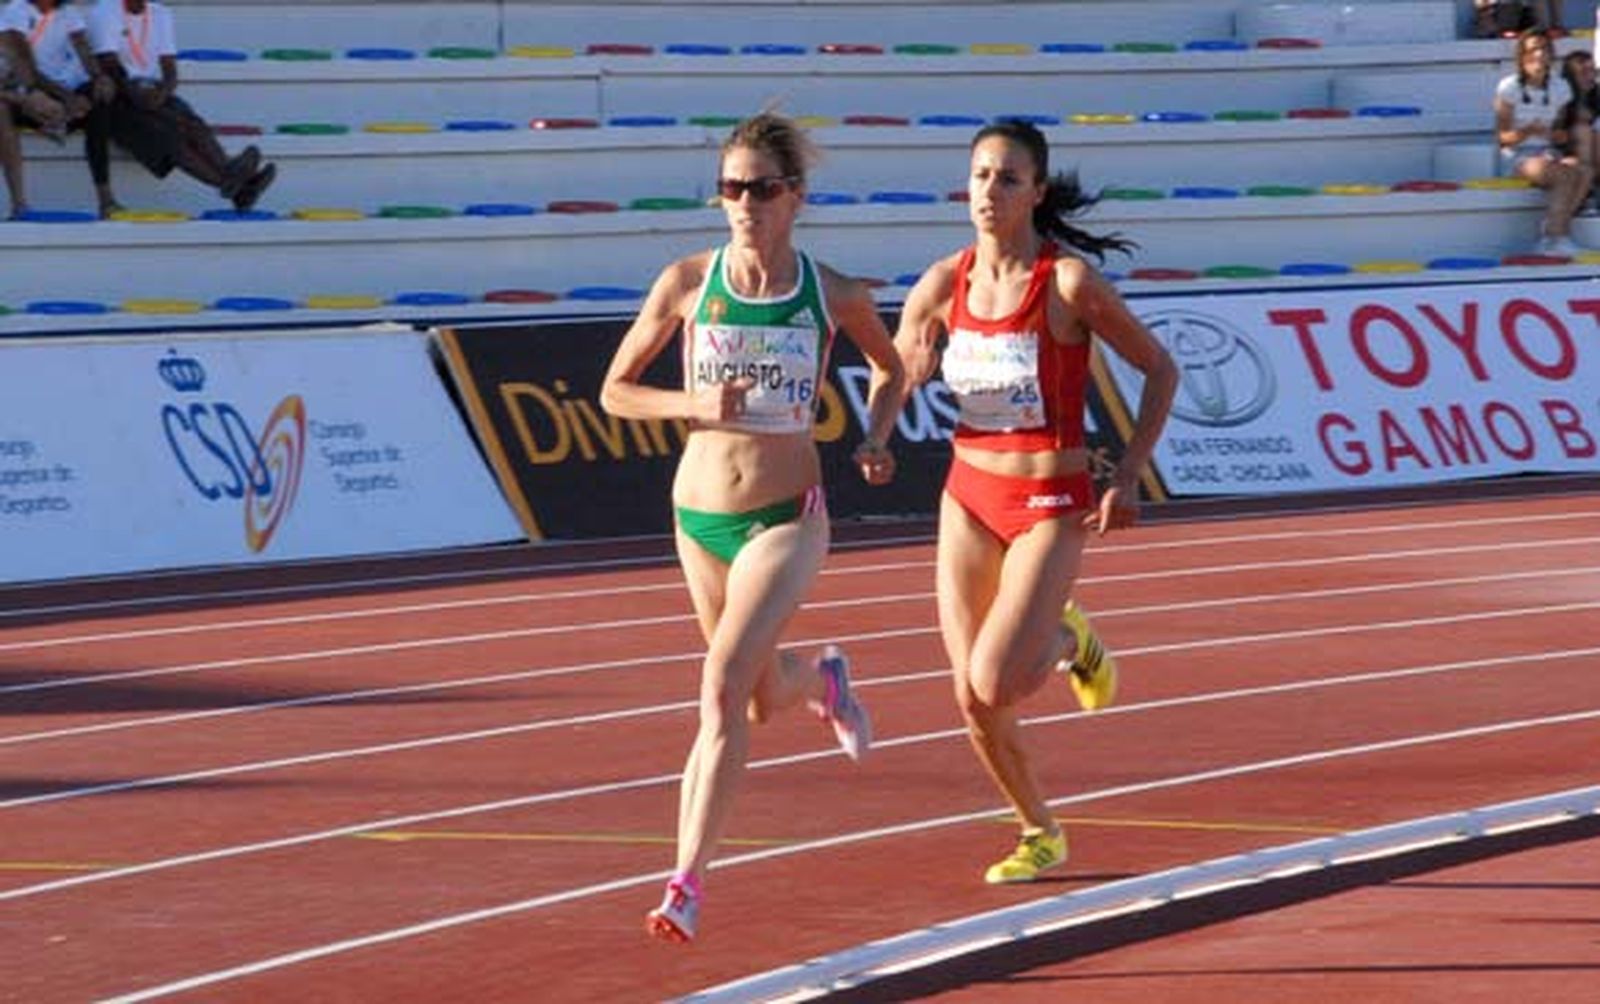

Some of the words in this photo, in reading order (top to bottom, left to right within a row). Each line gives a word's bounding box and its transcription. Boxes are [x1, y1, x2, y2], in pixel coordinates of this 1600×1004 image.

[697, 361, 783, 390] AUGUSTO
[784, 378, 812, 403] 16
[161, 402, 271, 500] CSD
[1317, 401, 1535, 476] GAMO
